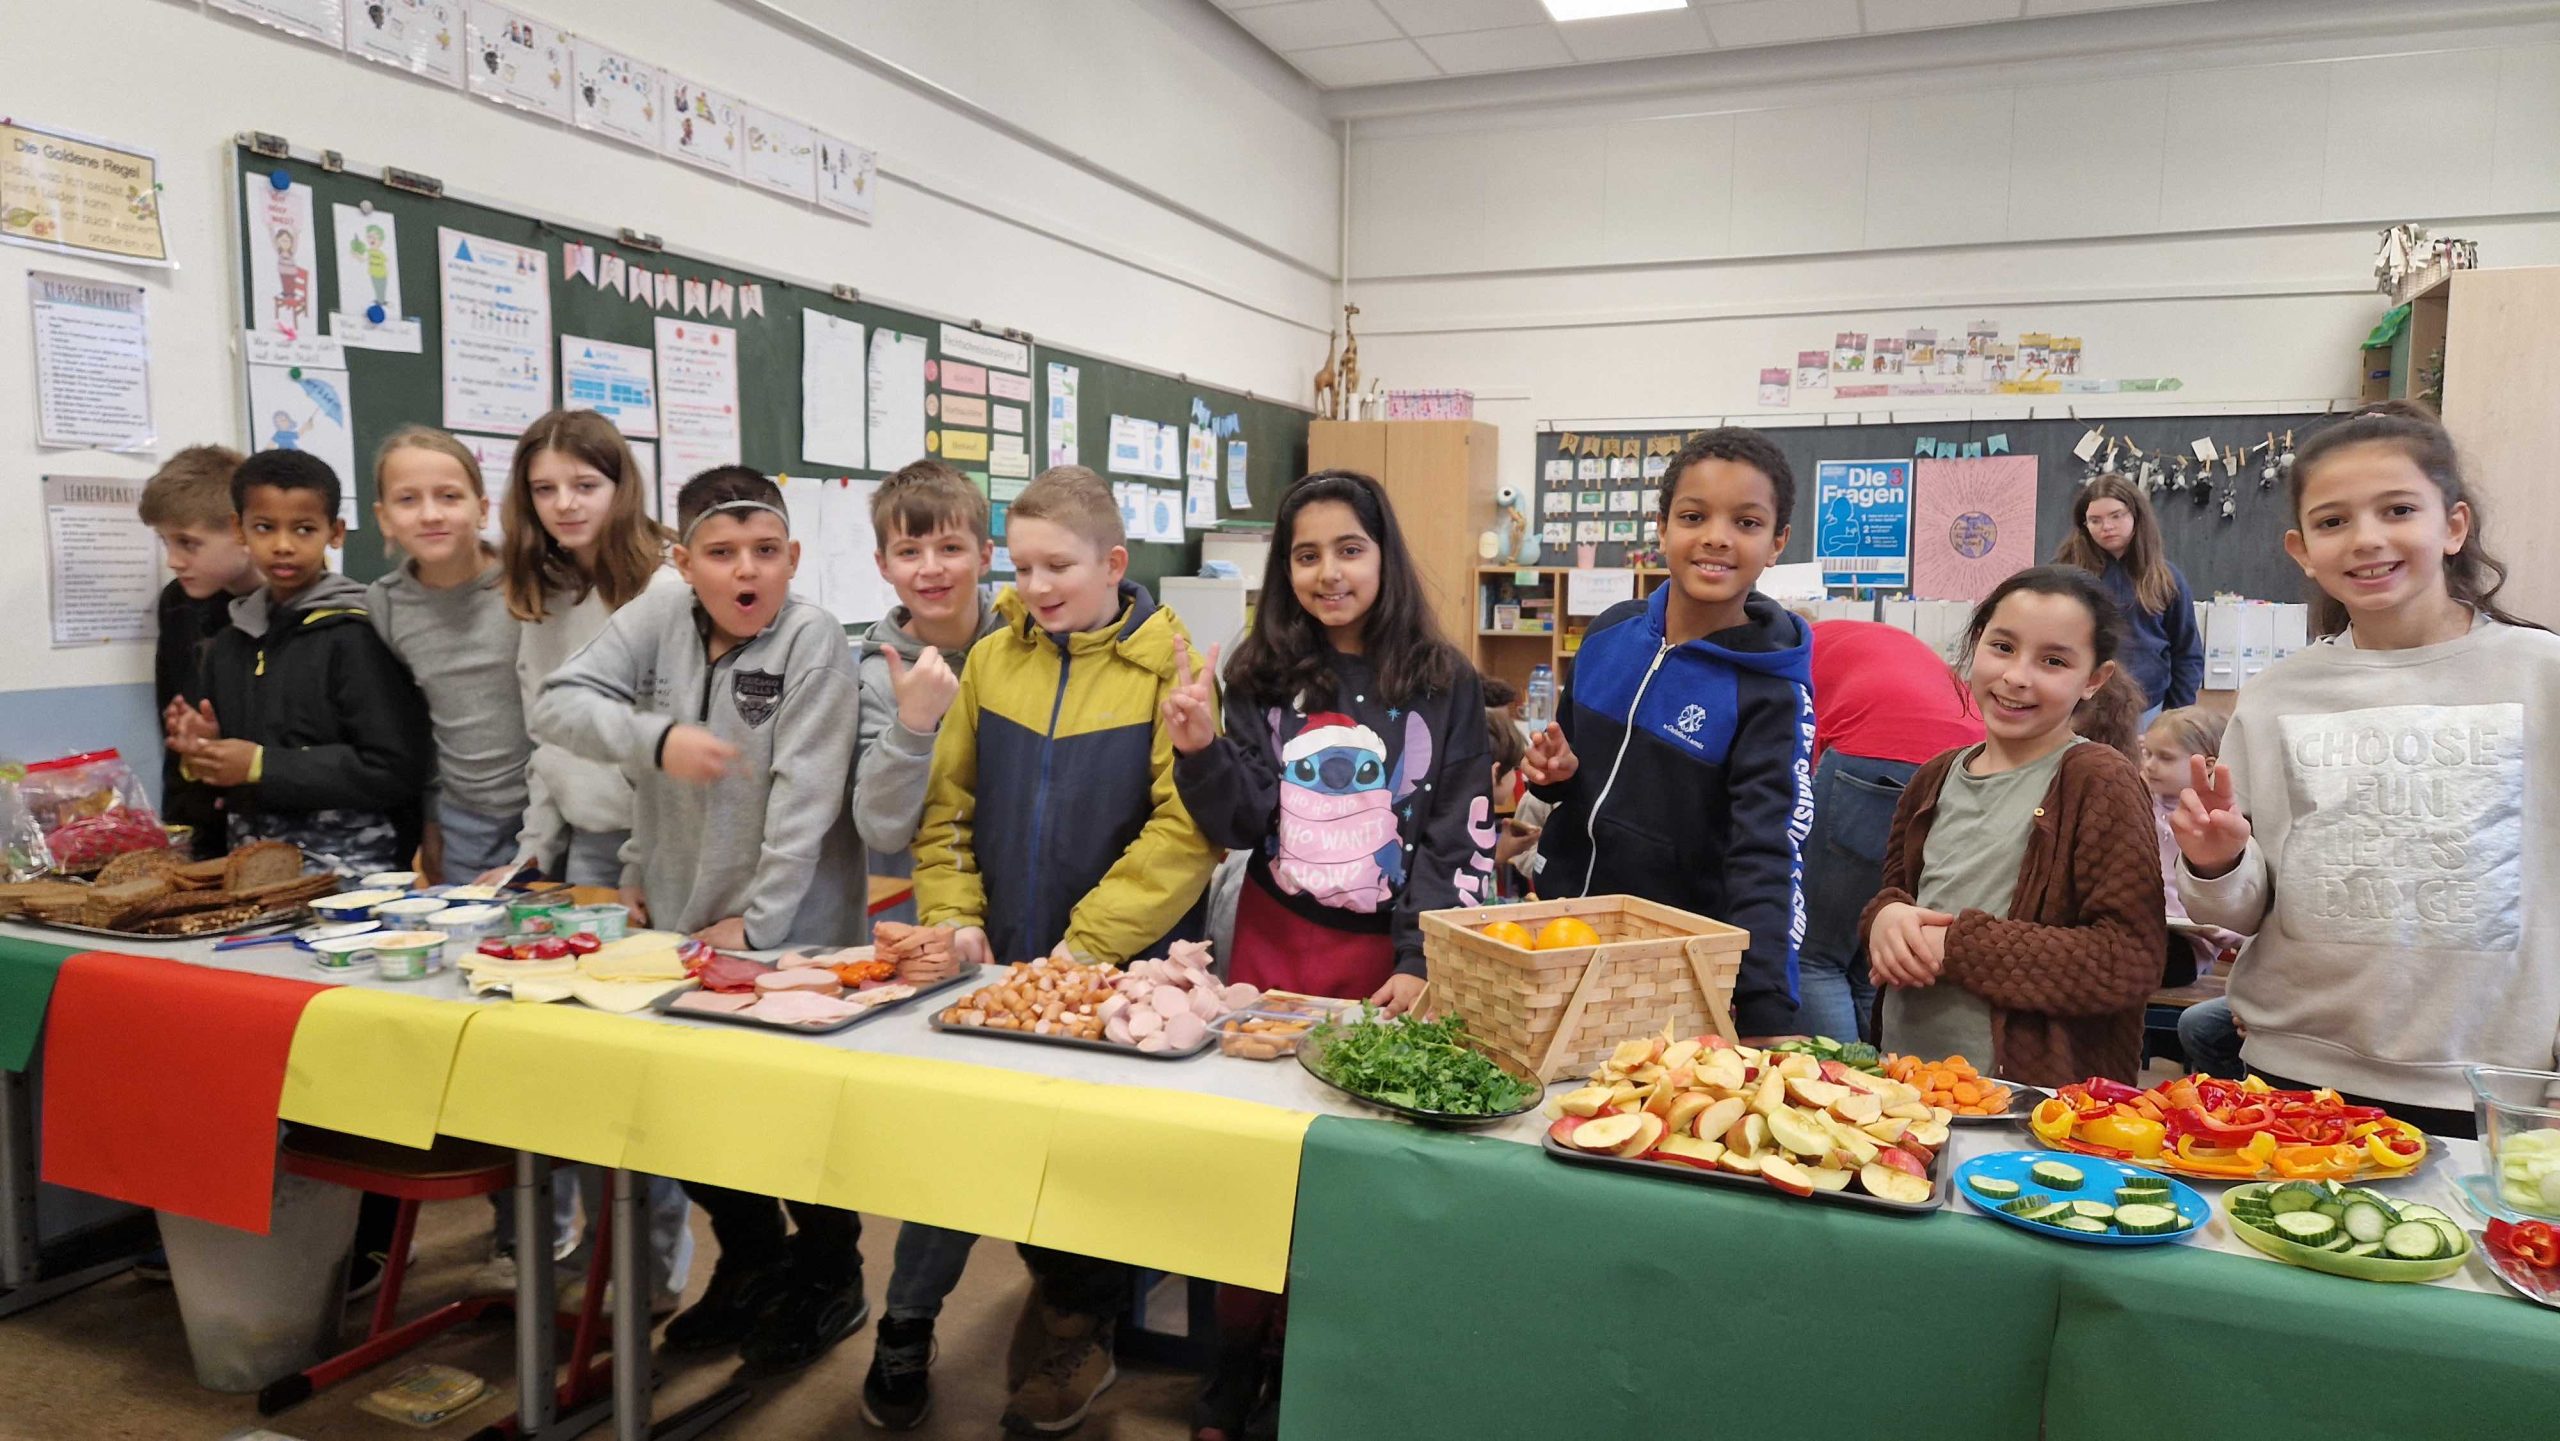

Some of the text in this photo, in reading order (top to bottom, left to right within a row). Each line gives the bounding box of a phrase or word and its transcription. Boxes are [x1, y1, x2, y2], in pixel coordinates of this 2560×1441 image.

[13, 137, 141, 179] Die Goldene Regel
[43, 280, 132, 313] KLASSENPUNKTE
[1848, 467, 1888, 487] Die
[1889, 467, 1905, 487] 3
[1822, 484, 1905, 508] Fragen
[1861, 514, 1867, 522] 1
[1863, 525, 1870, 534] 2
[1864, 535, 1871, 544] 3
[1801, 723, 1816, 755] BY
[2295, 727, 2499, 767] CHOOSE
[1320, 817, 1385, 851] WANTS
